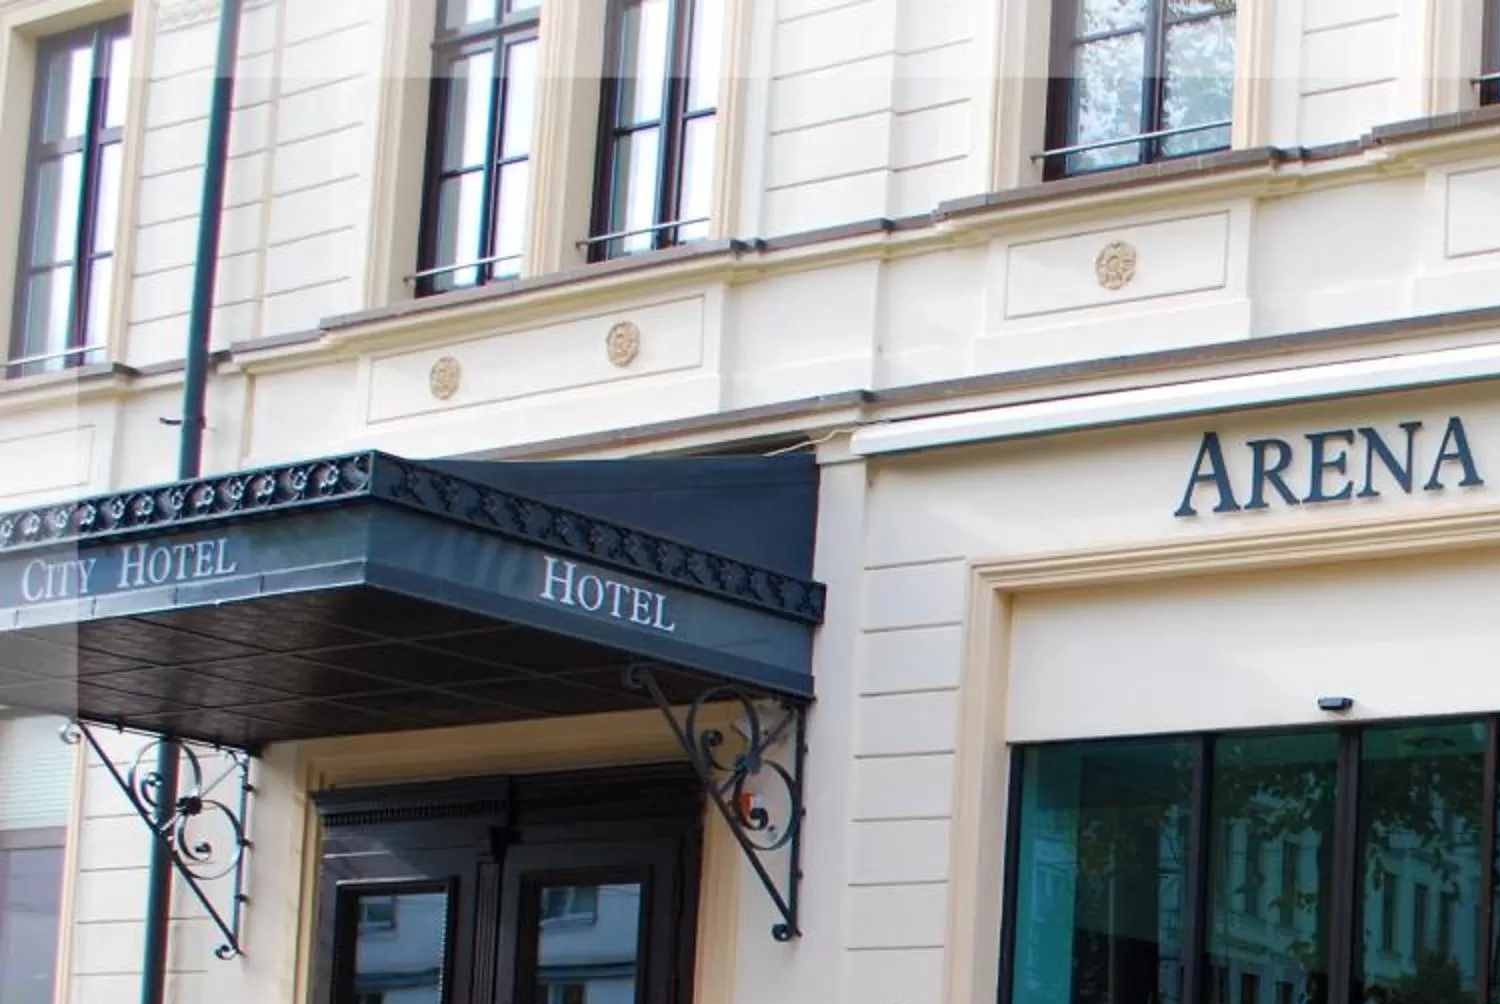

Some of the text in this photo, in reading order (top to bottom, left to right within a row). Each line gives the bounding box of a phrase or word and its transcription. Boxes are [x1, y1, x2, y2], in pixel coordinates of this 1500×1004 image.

[1174, 416, 1484, 517] ARENA
[21, 538, 238, 602] CITY HOTEL
[539, 555, 676, 634] HOTEL
